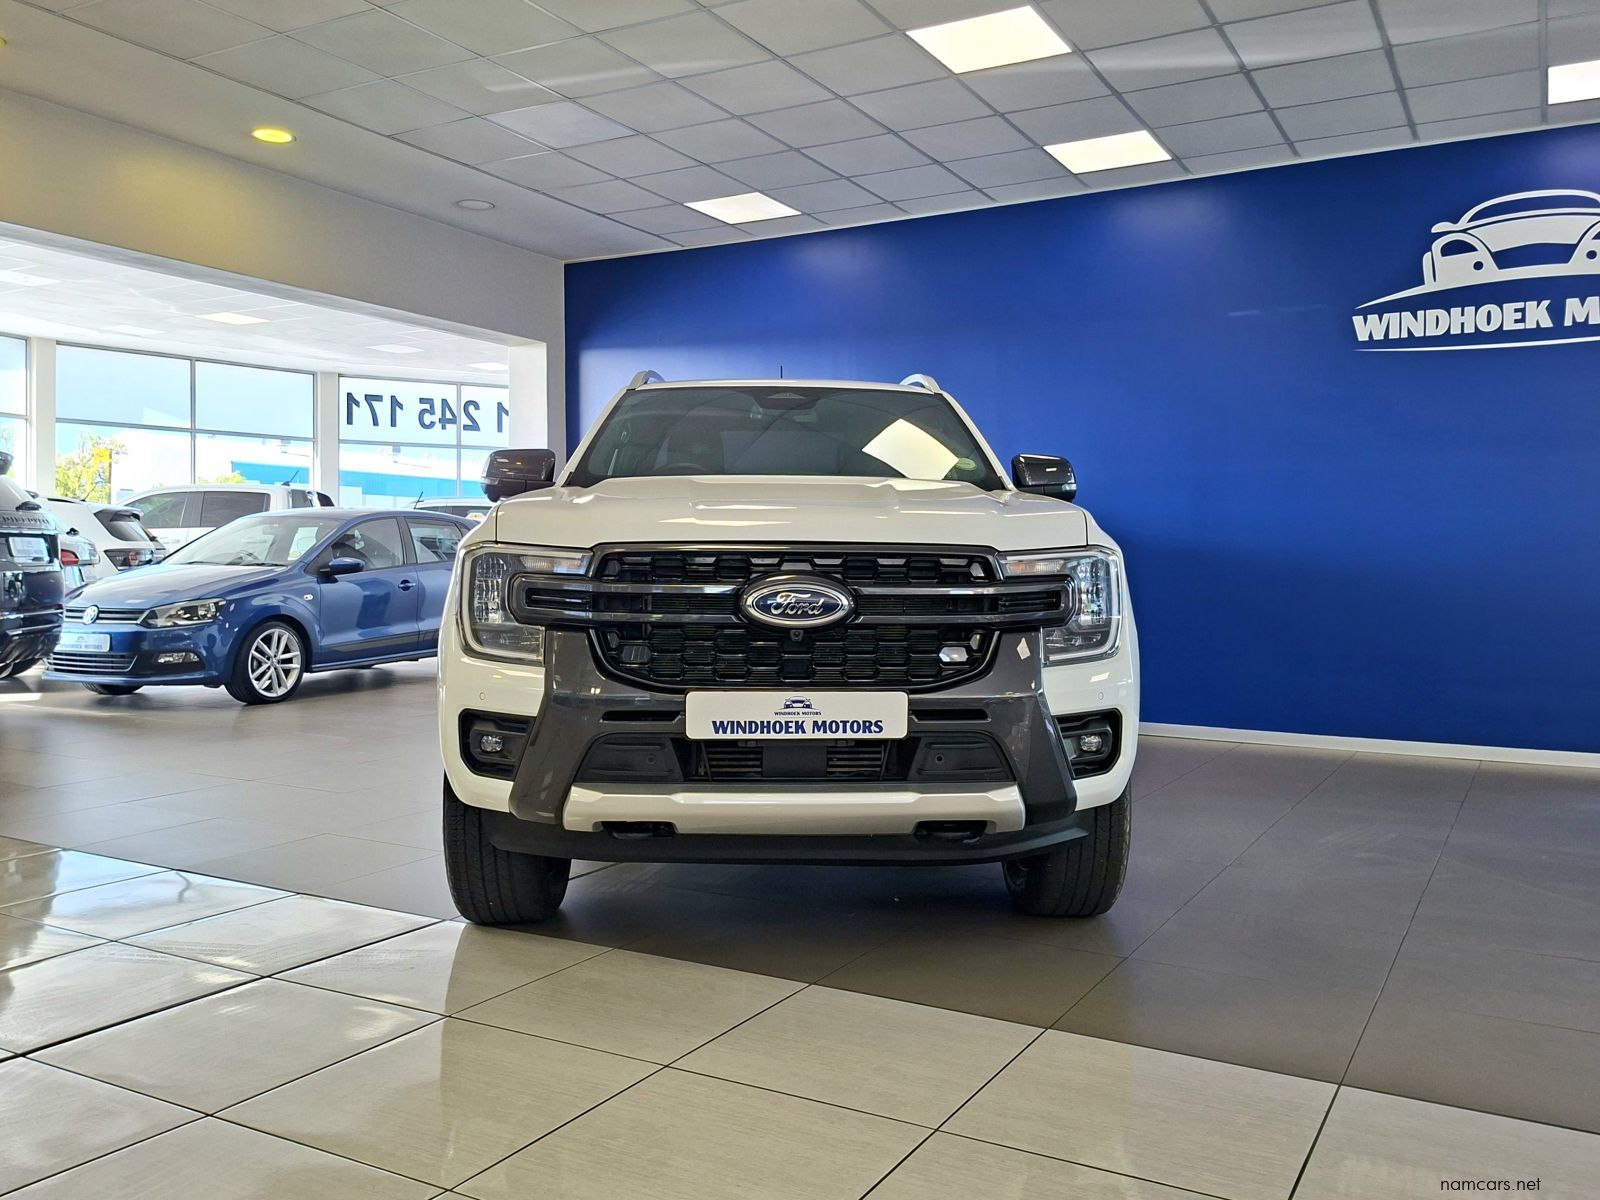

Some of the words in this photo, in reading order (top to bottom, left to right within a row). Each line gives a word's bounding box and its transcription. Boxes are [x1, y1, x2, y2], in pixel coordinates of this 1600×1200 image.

[1352, 300, 1553, 342] WINDHOEK
[767, 592, 824, 615] Ford
[712, 720, 807, 734] WINDHOEK
[812, 719, 883, 734] MOTORS
